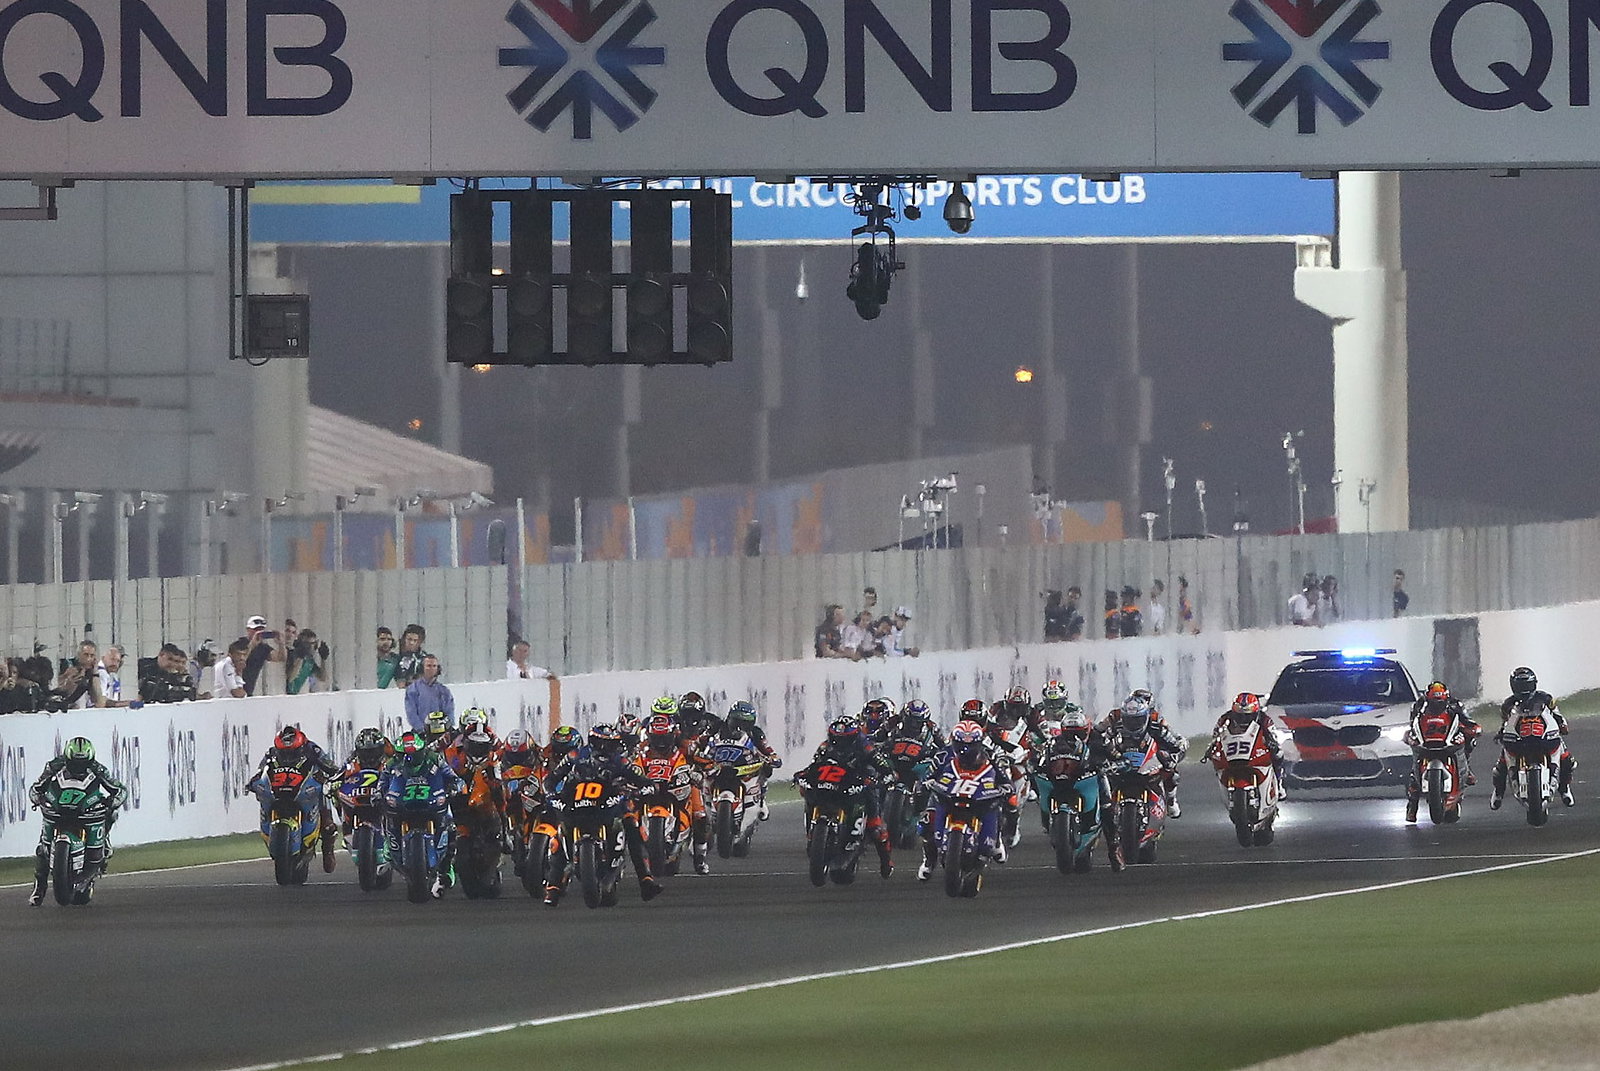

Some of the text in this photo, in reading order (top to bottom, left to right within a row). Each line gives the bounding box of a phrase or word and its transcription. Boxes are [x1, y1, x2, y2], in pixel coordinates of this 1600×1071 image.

[0, 0, 353, 122] QNB
[705, 0, 1078, 118] QNB
[750, 178, 890, 208] CIRCU
[1051, 175, 1146, 205] CLUB
[273, 767, 302, 775] TOTAL
[647, 765, 671, 781] 21
[818, 765, 847, 782] 12
[360, 773, 378, 787] 7
[951, 779, 980, 794] 16
[59, 789, 86, 804] 87
[403, 785, 431, 801] 33
[574, 782, 603, 800] 10
